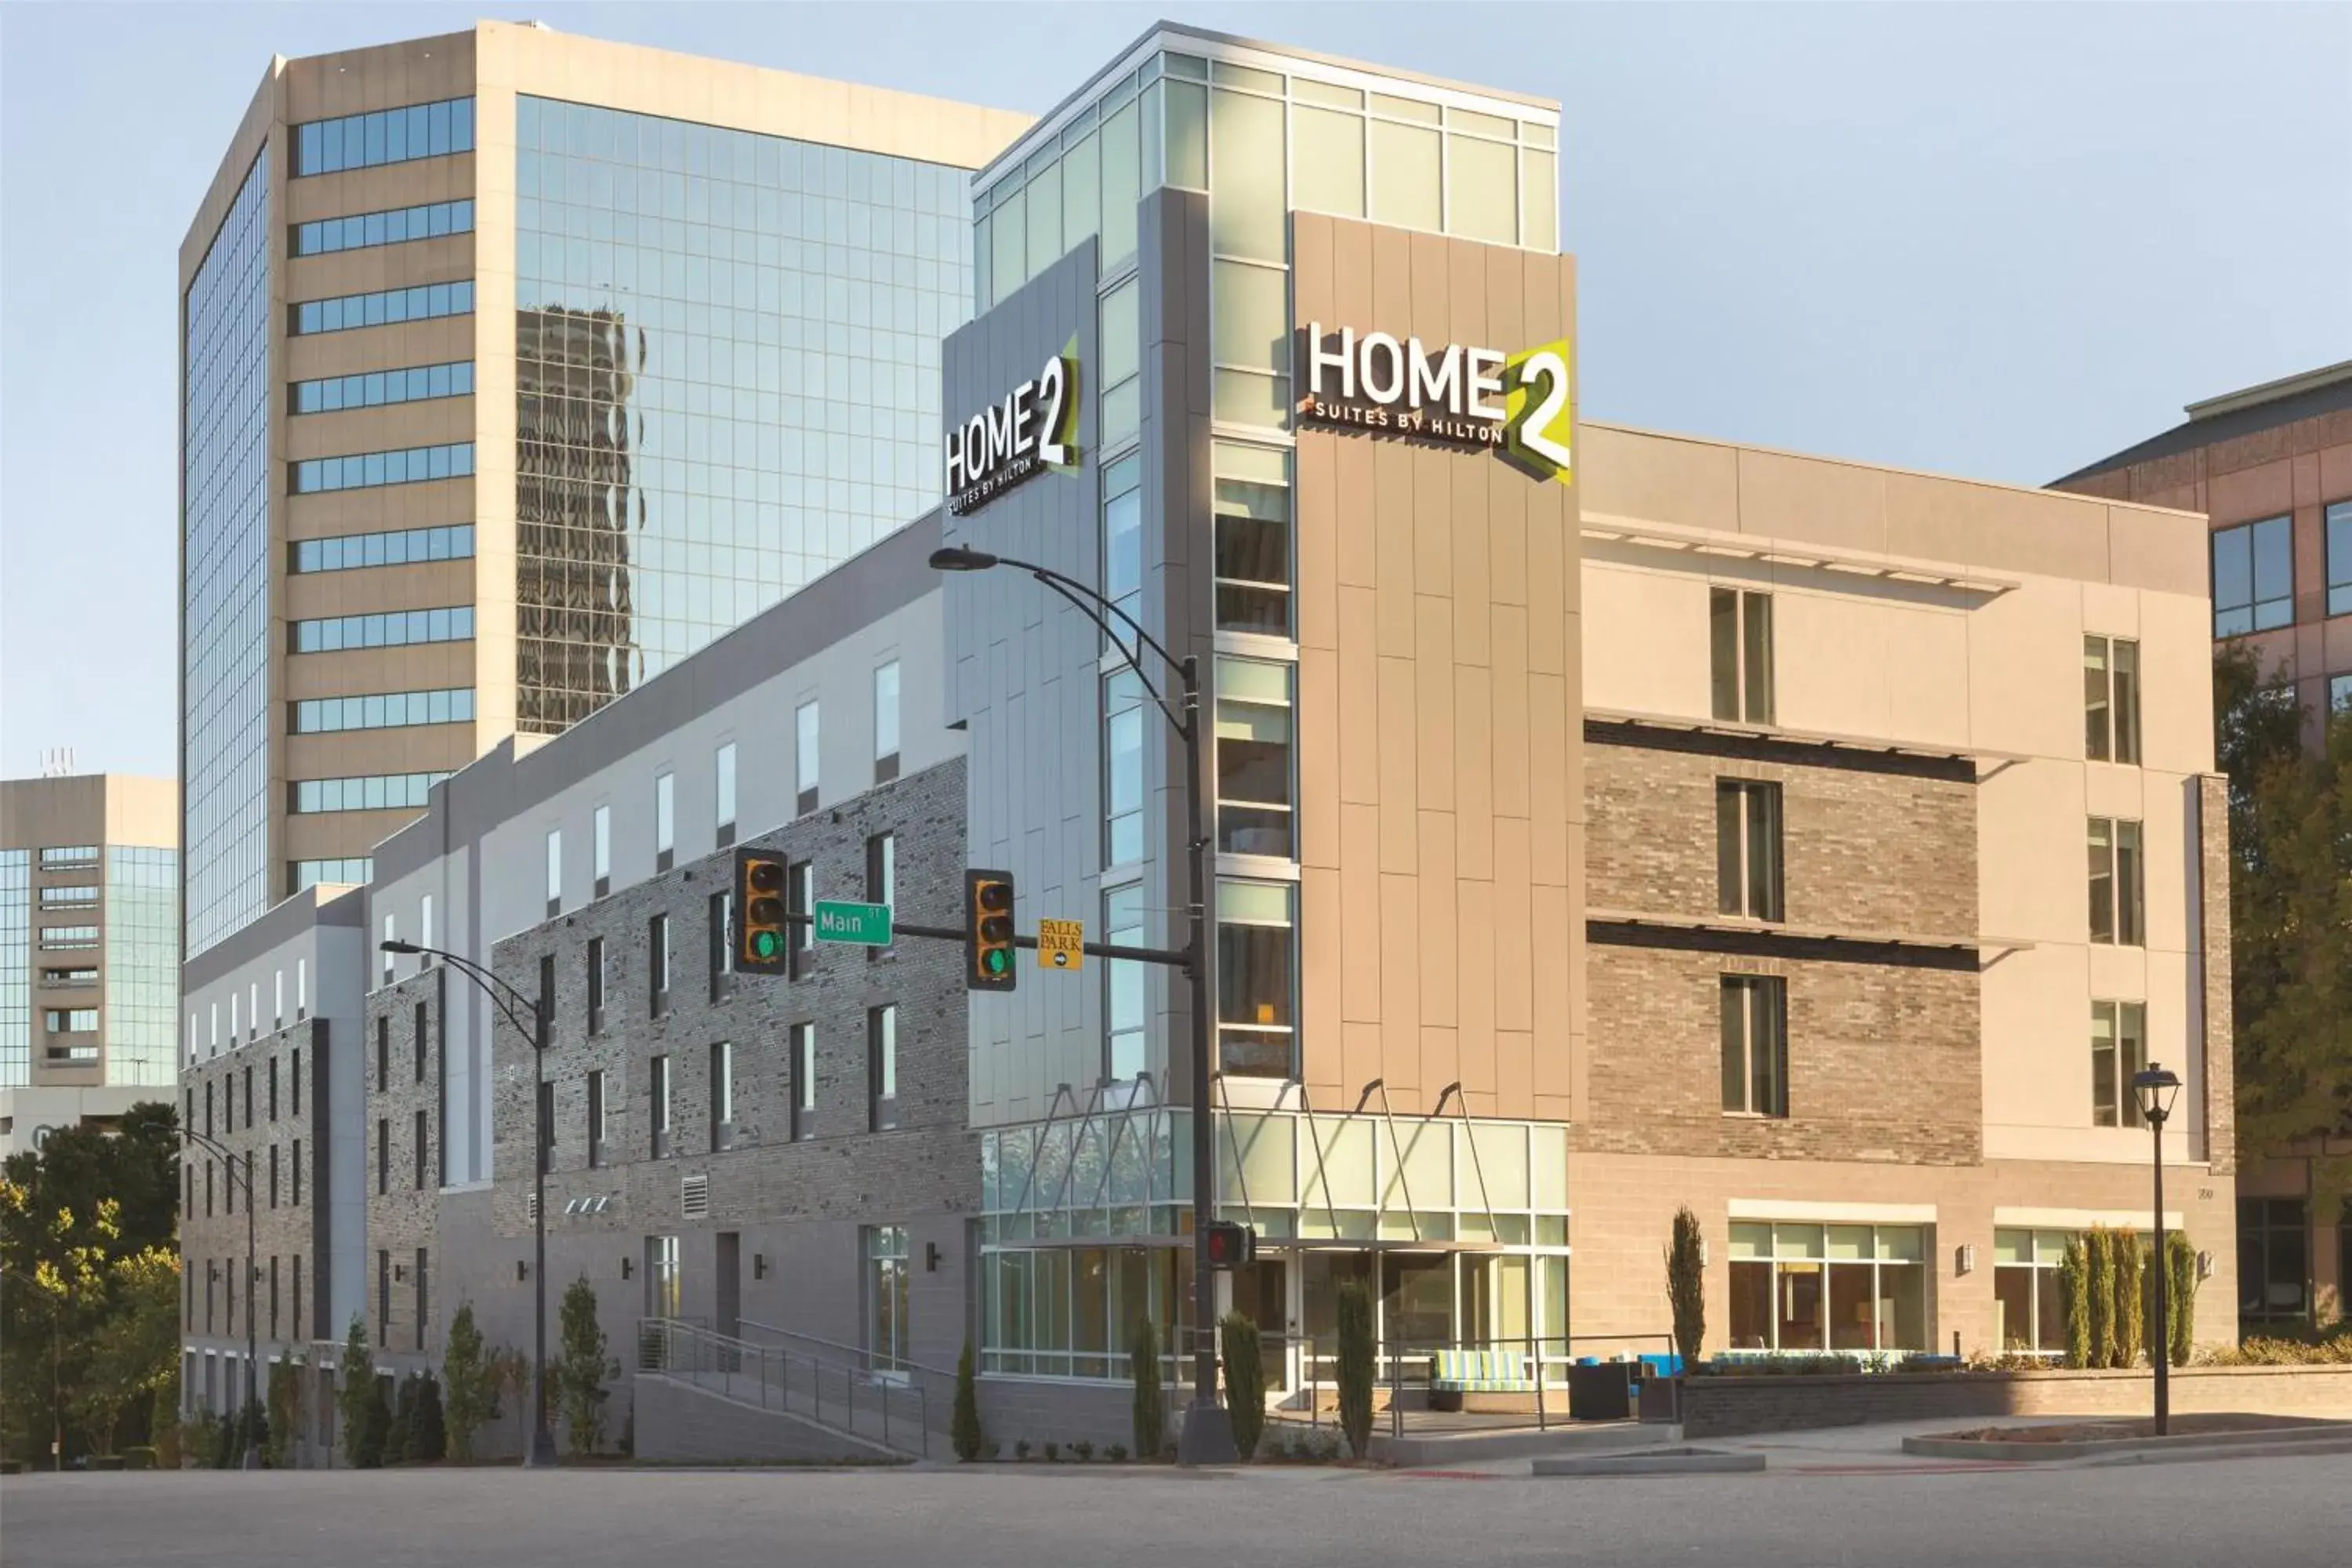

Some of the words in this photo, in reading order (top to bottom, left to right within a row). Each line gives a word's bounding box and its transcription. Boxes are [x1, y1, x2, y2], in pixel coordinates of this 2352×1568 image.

[1315, 401, 1388, 426] SUITES
[1398, 412, 1423, 431] BY
[1432, 419, 1504, 444] HILTON
[947, 487, 979, 517] SUITES
[982, 480, 993, 495] BY
[996, 456, 1031, 488] HILTON
[821, 909, 862, 934] Main
[1040, 919, 1081, 935] FALLS
[1040, 934, 1080, 951] PARK
